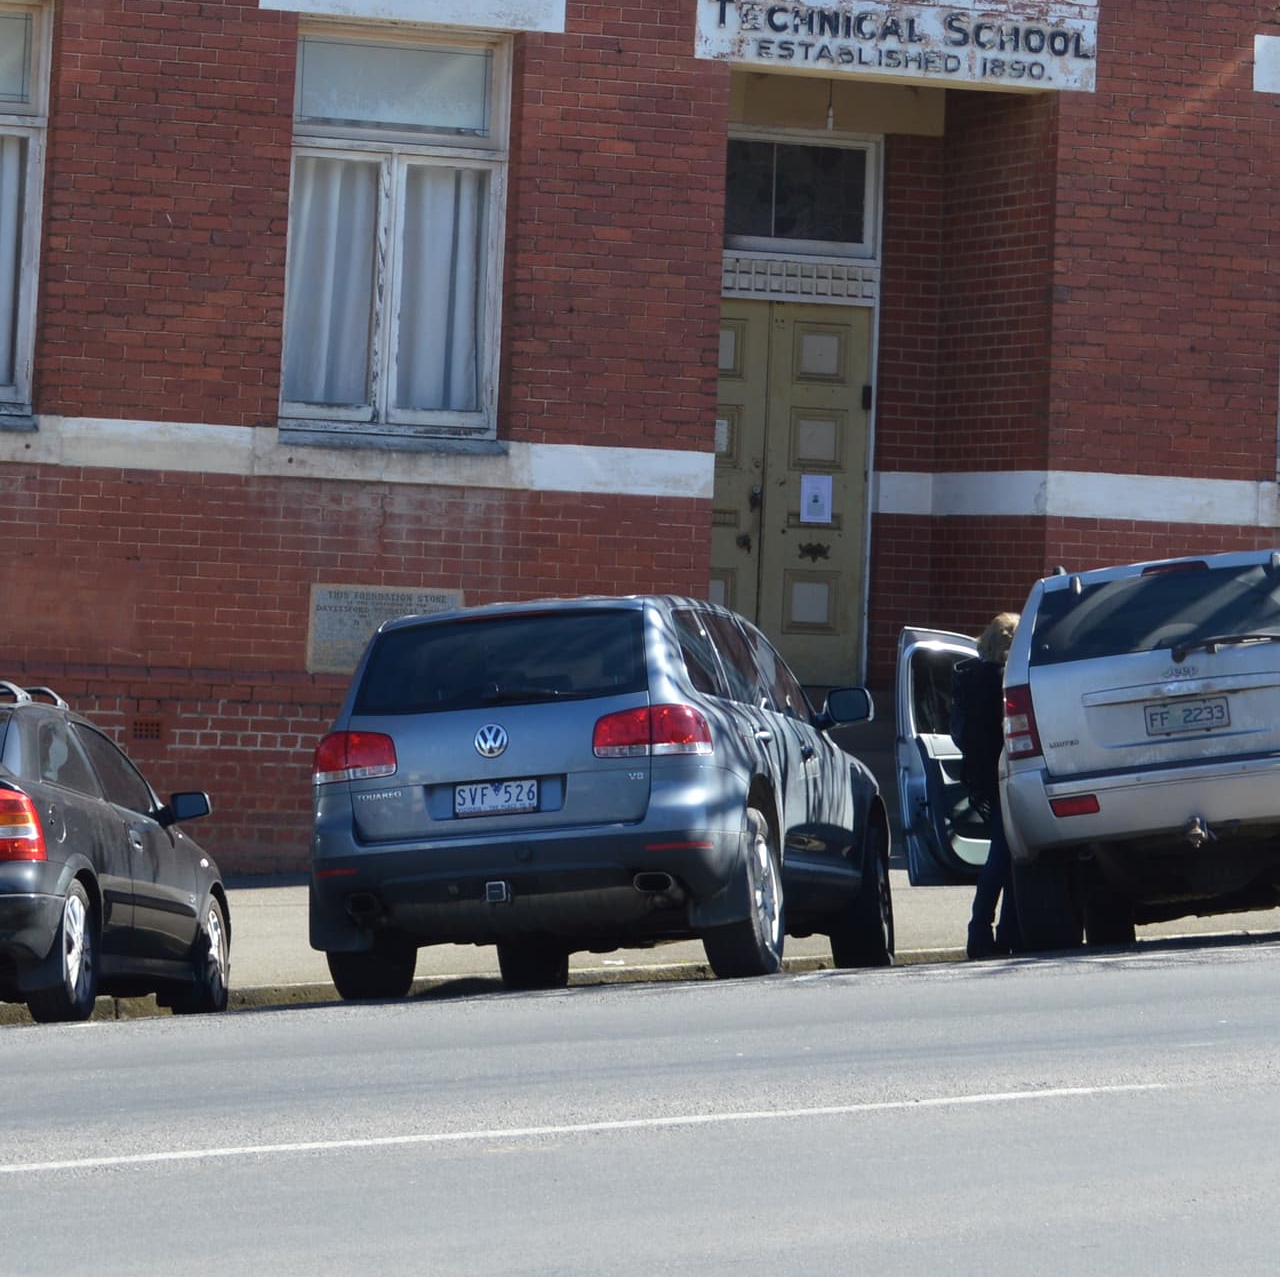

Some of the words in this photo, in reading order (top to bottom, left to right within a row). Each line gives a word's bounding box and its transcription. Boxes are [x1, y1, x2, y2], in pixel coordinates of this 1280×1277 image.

[944, 11, 1096, 60] SCHOOL
[755, 39, 961, 73] ESTABLISHED
[1149, 710, 1169, 728] FF
[1182, 704, 1225, 724] 2233
[357, 790, 402, 802] TOUAREG
[457, 786, 488, 807] SVF
[504, 783, 535, 803] 526
